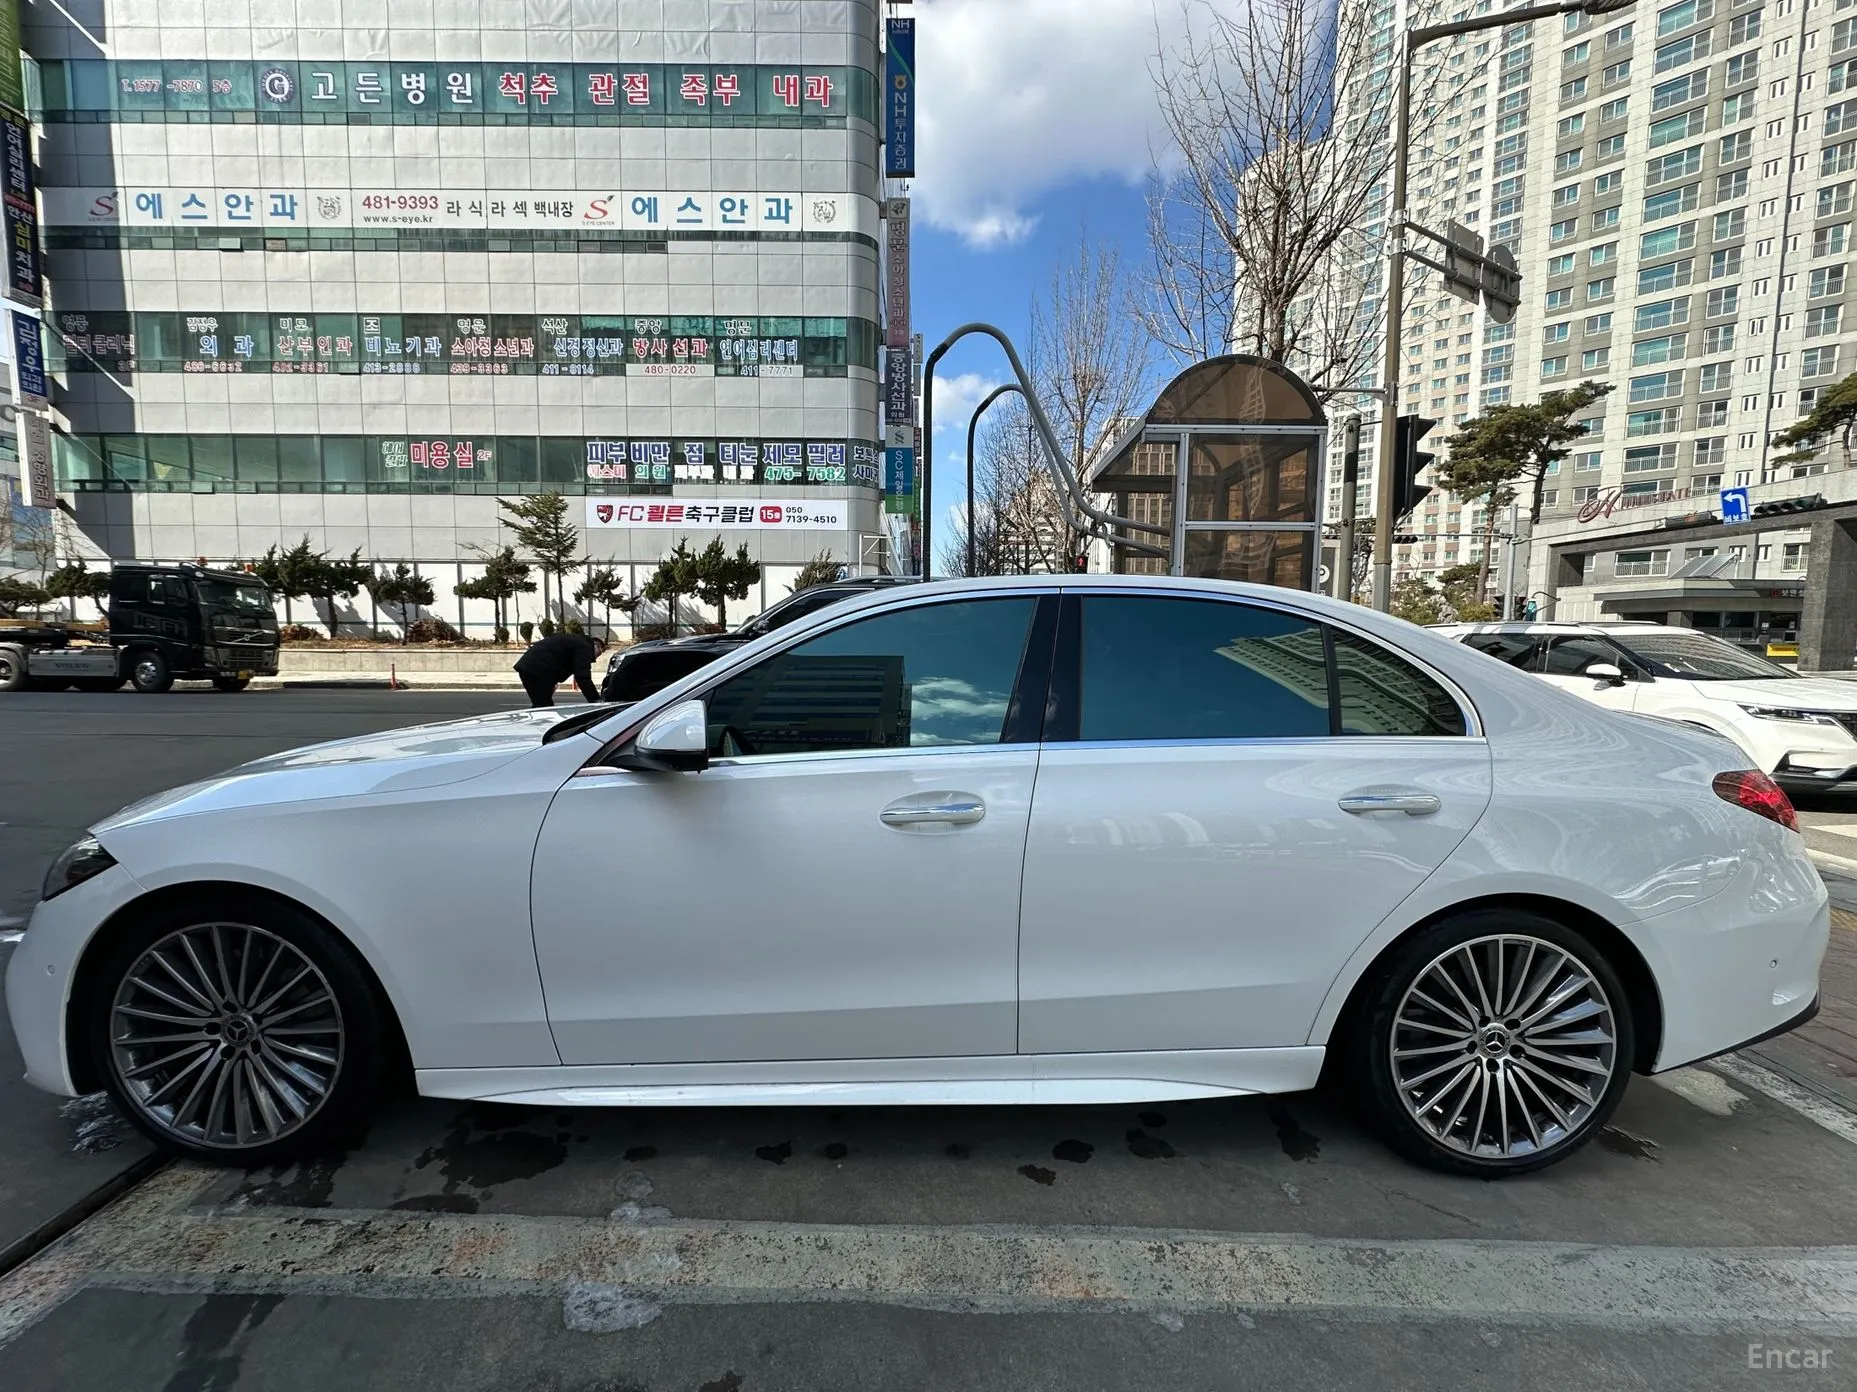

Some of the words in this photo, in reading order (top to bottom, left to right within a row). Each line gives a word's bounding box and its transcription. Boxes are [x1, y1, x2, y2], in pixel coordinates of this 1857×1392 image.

[311, 72, 475, 105] 고든병원
[499, 72, 558, 105] 척추
[588, 73, 650, 105] 관절
[679, 74, 741, 106] 족부
[773, 75, 833, 107] 내과
[135, 192, 298, 221] 에스안과
[362, 195, 439, 210] 481-9393
[446, 200, 483, 217] 라식
[491, 200, 527, 218] 라섹
[534, 201, 574, 218] 백내장
[631, 196, 793, 224] 에스안과
[199, 335, 254, 357] 외과
[277, 336, 353, 357] 산부인과
[364, 336, 442, 357] 비뇨기과
[553, 337, 623, 358] 신경정신과
[632, 338, 708, 358] 방사선과
[644, 365, 697, 375] 480-0220
[410, 441, 474, 469] 미용실
[476, 449, 492, 461] 2F
[586, 442, 626, 464] 피부
[630, 442, 670, 464] 비만
[684, 442, 704, 465] 점
[719, 443, 758, 465] 티눈
[762, 443, 803, 465] 제모
[807, 443, 846, 466] 필러
[635, 464, 666, 480] 의원
[785, 506, 803, 514] 050
[785, 515, 837, 524] 7139-4510
[1724, 513, 1751, 524] 비보호
